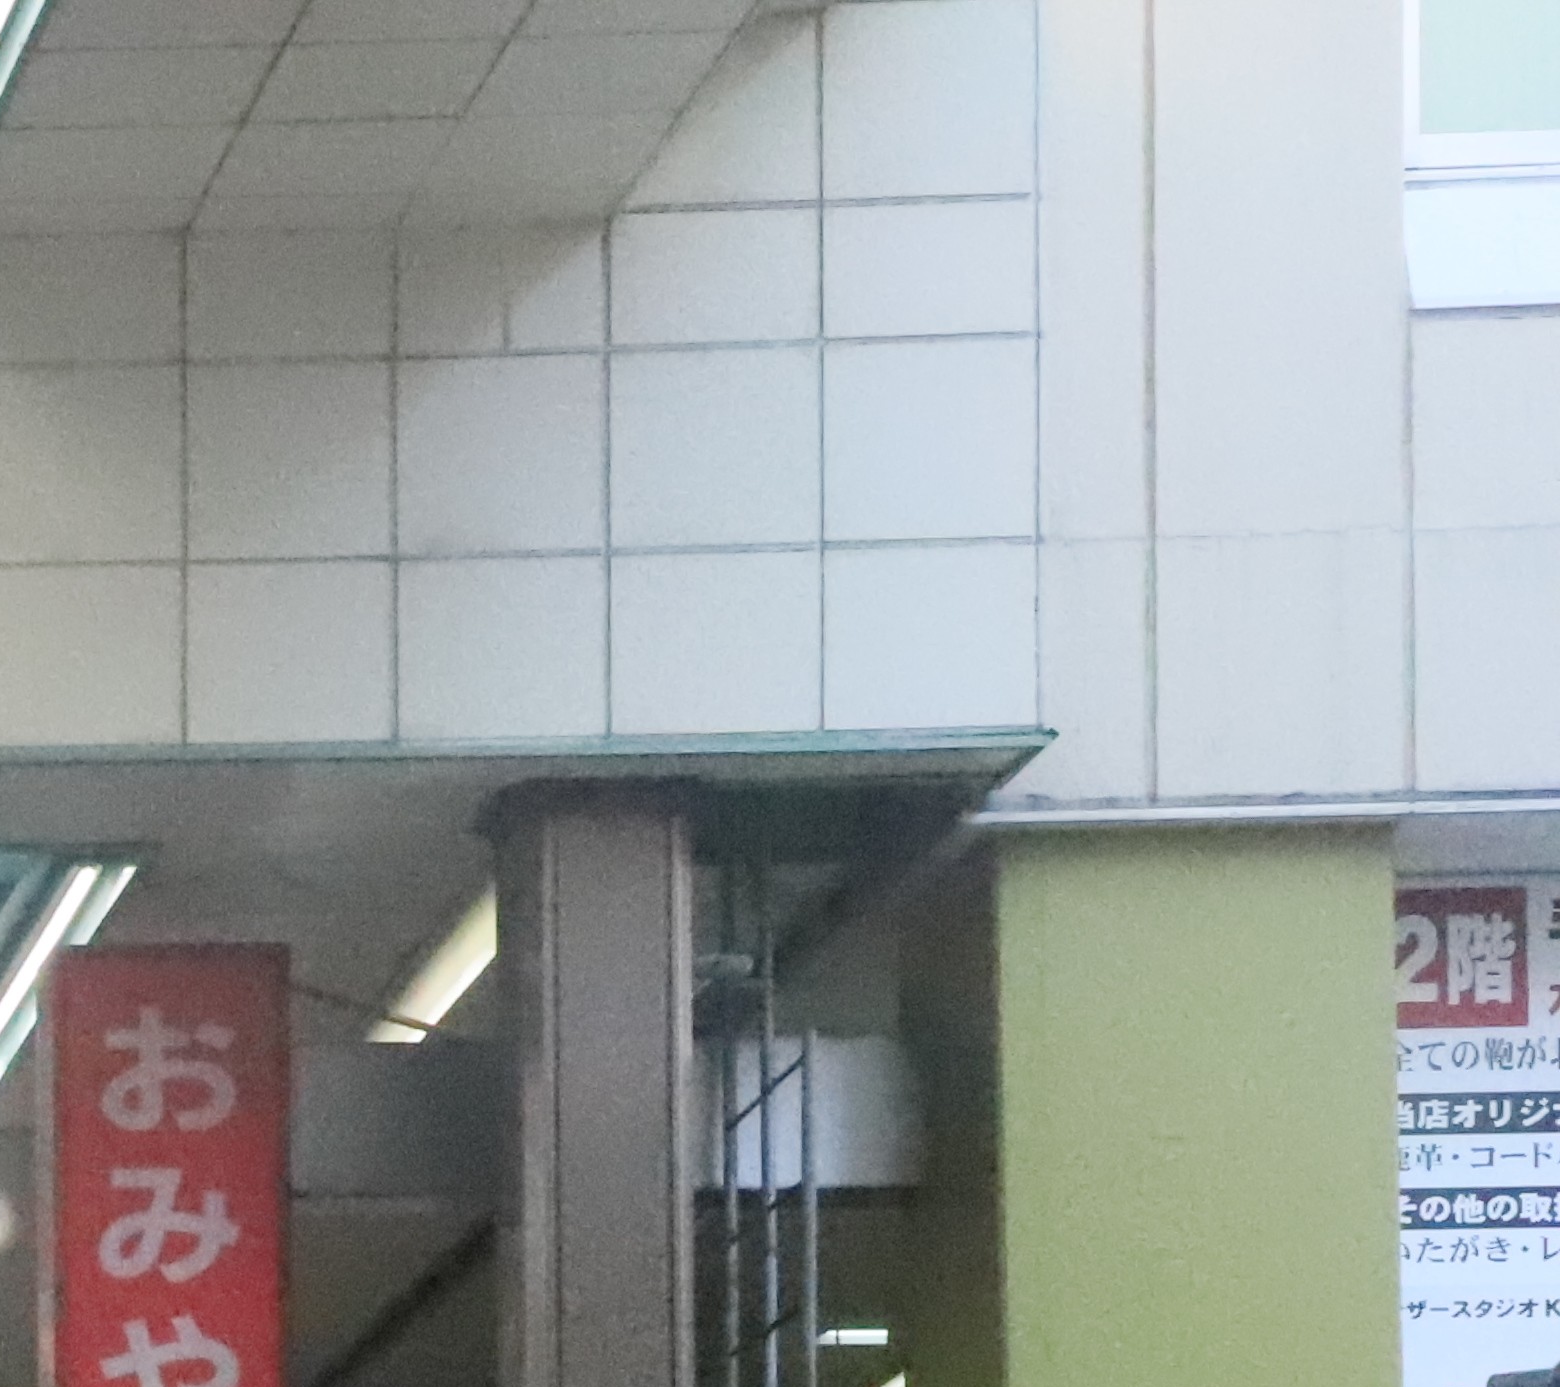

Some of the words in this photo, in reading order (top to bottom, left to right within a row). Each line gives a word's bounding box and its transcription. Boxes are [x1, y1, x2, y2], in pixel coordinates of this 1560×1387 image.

[1398, 1100, 1560, 1129] 当店オリジ
